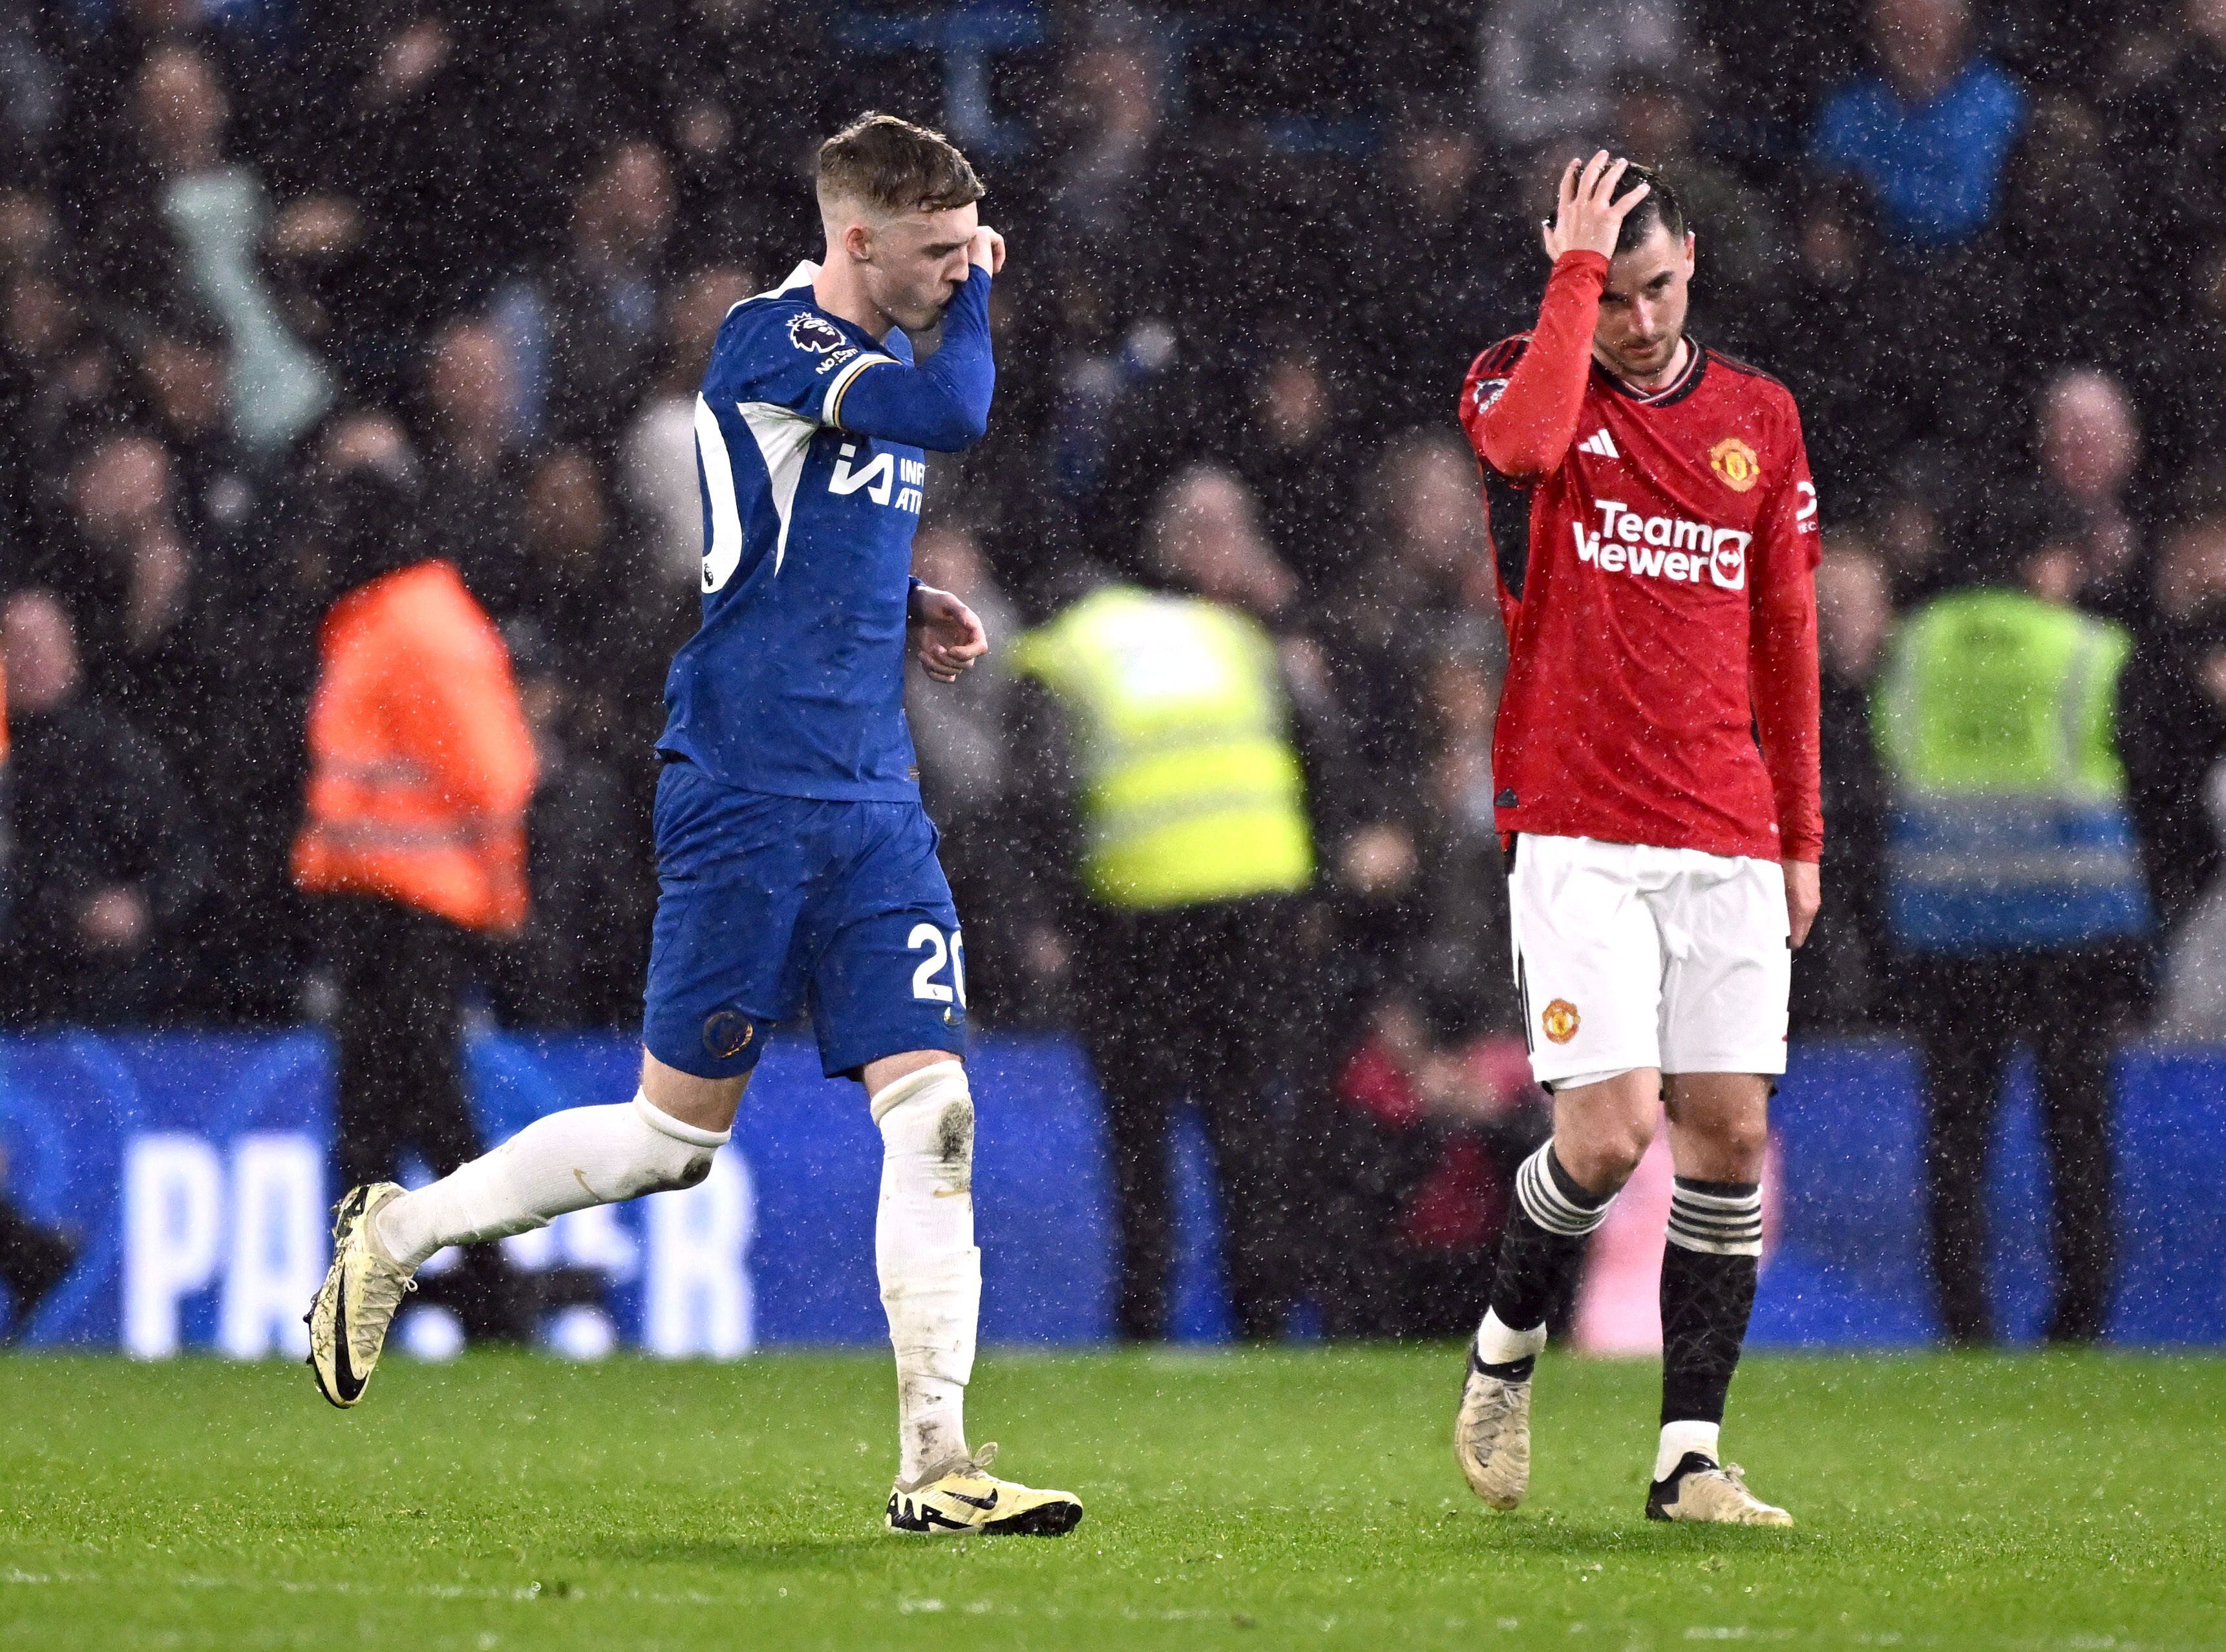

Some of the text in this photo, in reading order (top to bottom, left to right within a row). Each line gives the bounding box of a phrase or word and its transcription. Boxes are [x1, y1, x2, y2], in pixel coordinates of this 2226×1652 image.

[815, 357, 835, 375] NO
[1573, 521, 1709, 583] Viewer
[1594, 499, 1713, 552] Team
[123, 1131, 755, 1360] PAR
